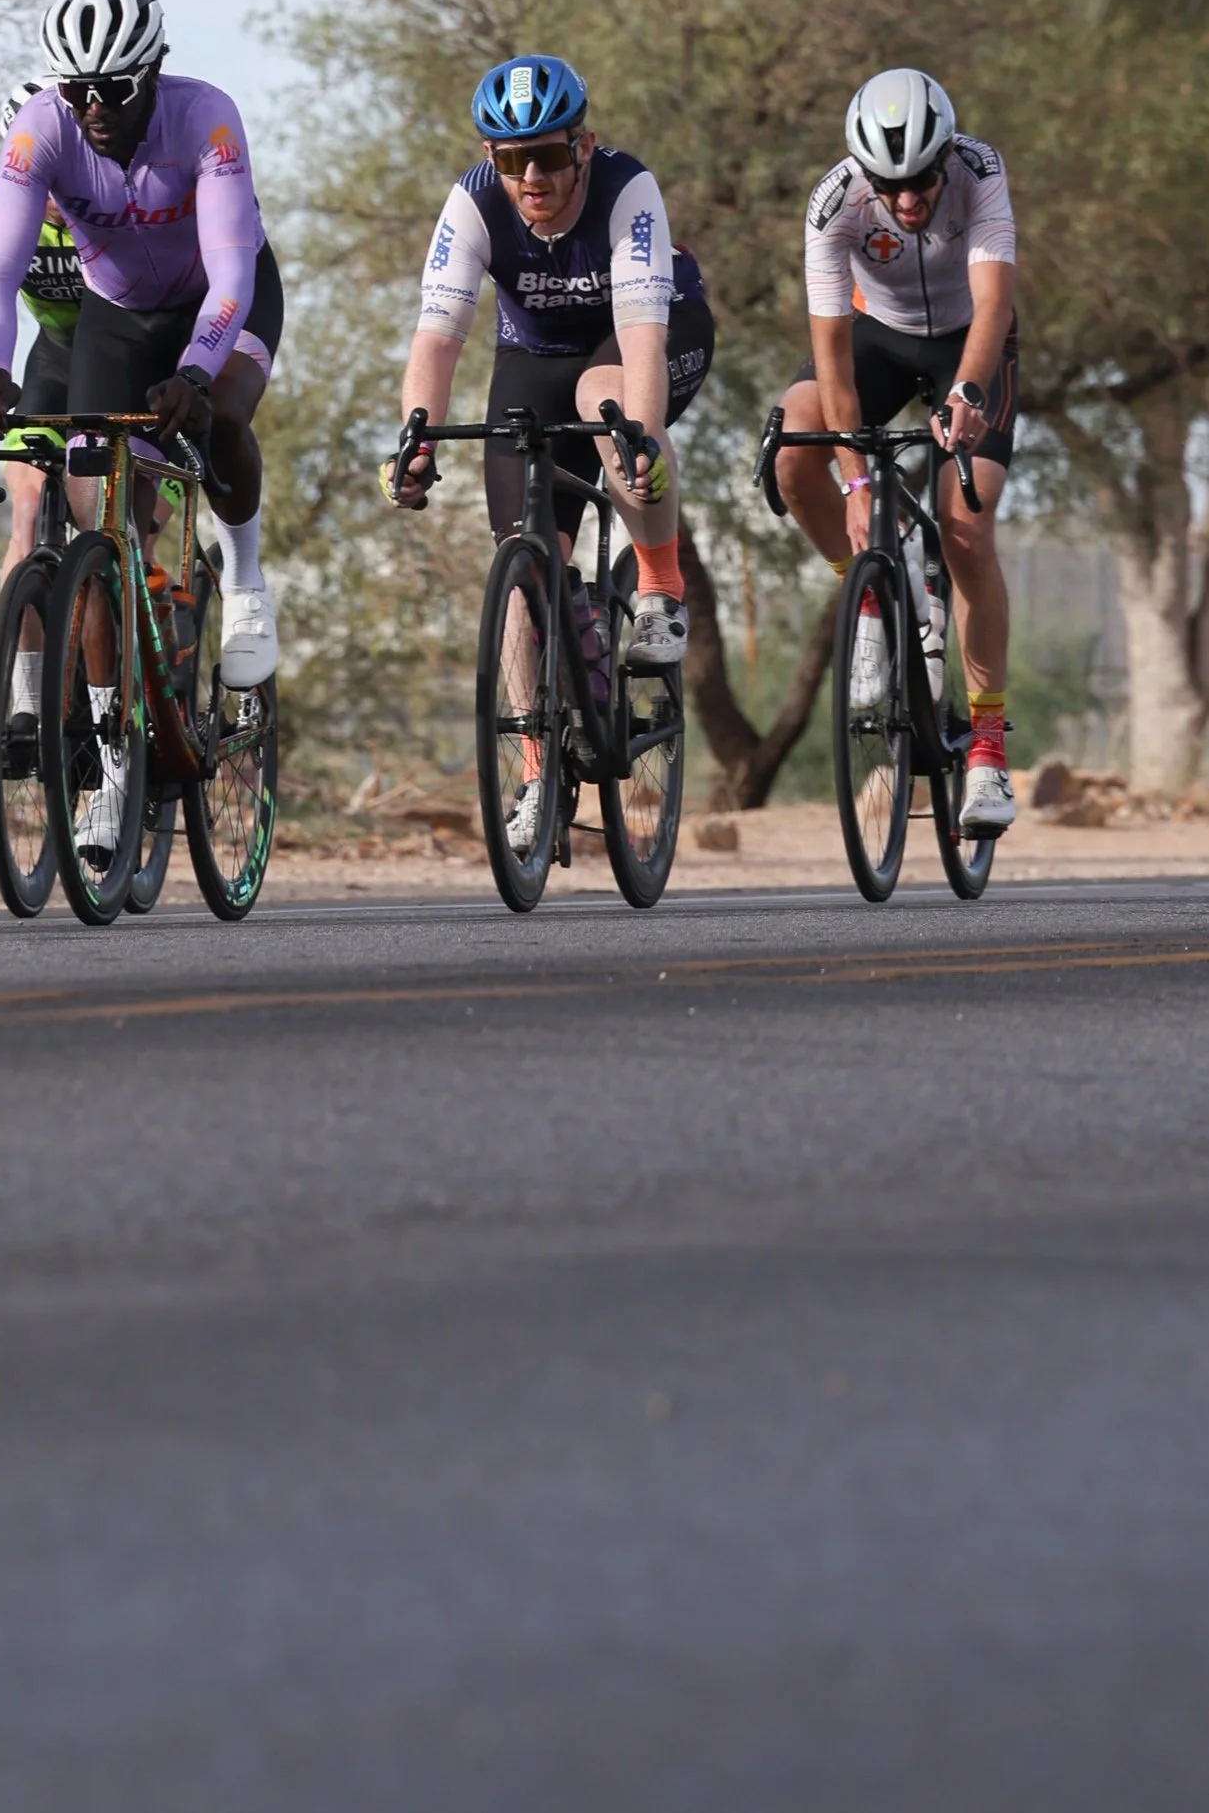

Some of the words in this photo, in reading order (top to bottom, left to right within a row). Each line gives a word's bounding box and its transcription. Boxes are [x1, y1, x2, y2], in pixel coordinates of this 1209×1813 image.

[512, 70, 530, 99] 6903
[808, 167, 849, 226] HAMMER
[435, 283, 474, 298] Ranch
[516, 271, 611, 293] Bicycle
